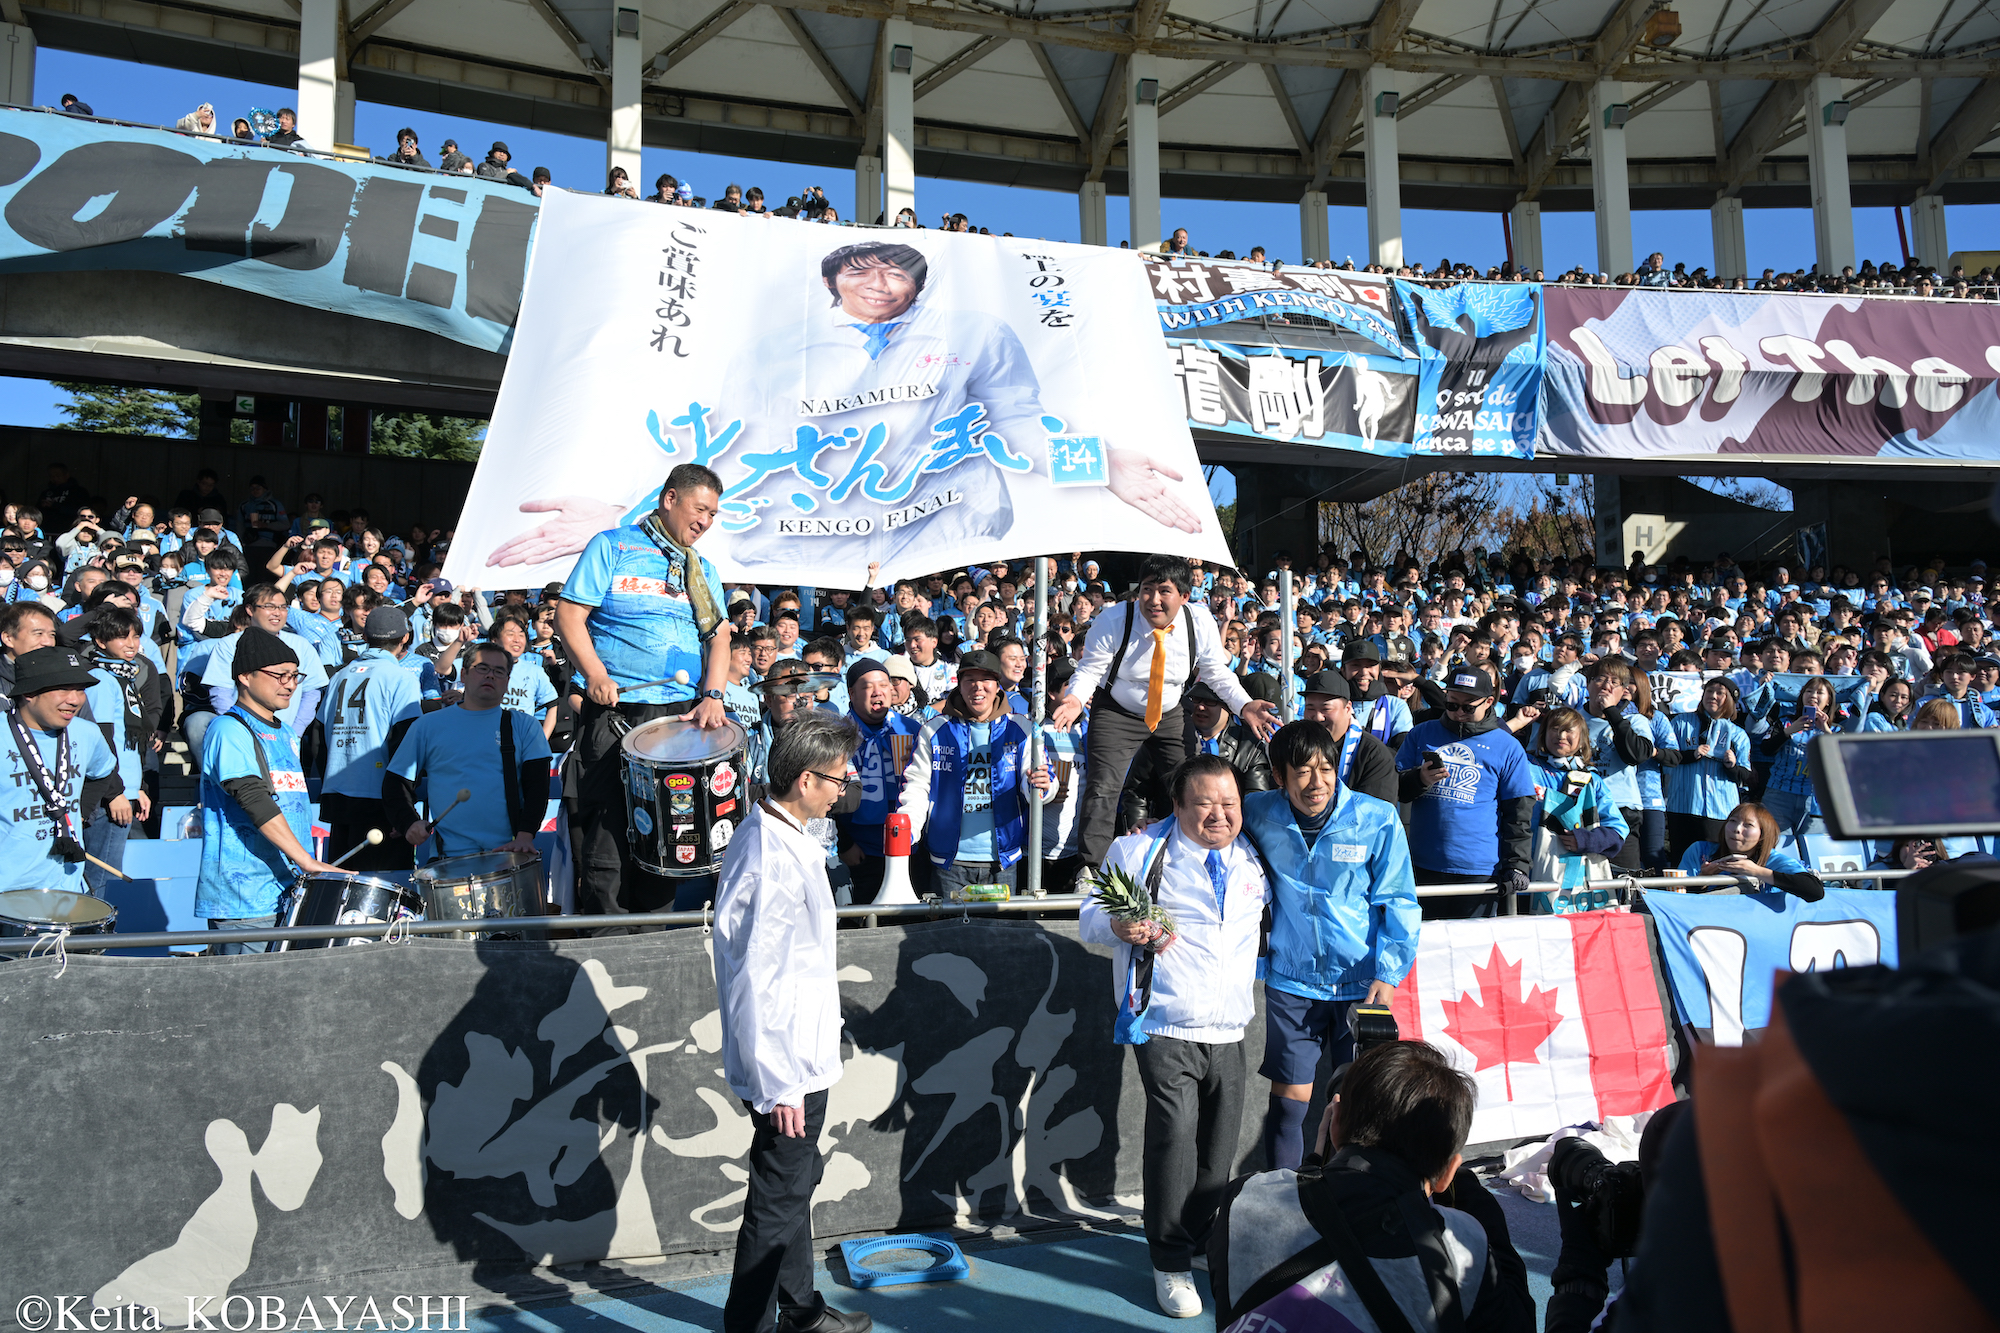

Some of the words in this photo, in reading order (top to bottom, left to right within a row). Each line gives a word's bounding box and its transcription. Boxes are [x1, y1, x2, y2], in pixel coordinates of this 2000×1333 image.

[650, 220, 707, 358] ご賞味あれ
[1021, 253, 1074, 327] 上の宴を
[1159, 297, 1247, 329] WITH
[1255, 291, 1347, 318] KENGO
[1366, 315, 1400, 349] 2020
[1467, 368, 1487, 387] 10
[1569, 326, 1749, 407] Let
[1760, 334, 1972, 413] The
[800, 383, 937, 415] NAKAMURA
[1488, 383, 1517, 406] de
[1414, 409, 1534, 434] KAWASAKI
[1472, 438, 1497, 452] se
[1500, 433, 1537, 455] põ
[1059, 443, 1097, 474] 14
[778, 518, 872, 535] KENGO
[886, 489, 961, 528] FINAL
[1636, 525, 1653, 546] H
[803, 589, 827, 597] FUJITSU
[810, 597, 820, 607] 14
[334, 677, 370, 724] 14
[933, 745, 956, 756] PRIDE
[933, 760, 953, 772] BLUE
[668, 777, 691, 788] gol.
